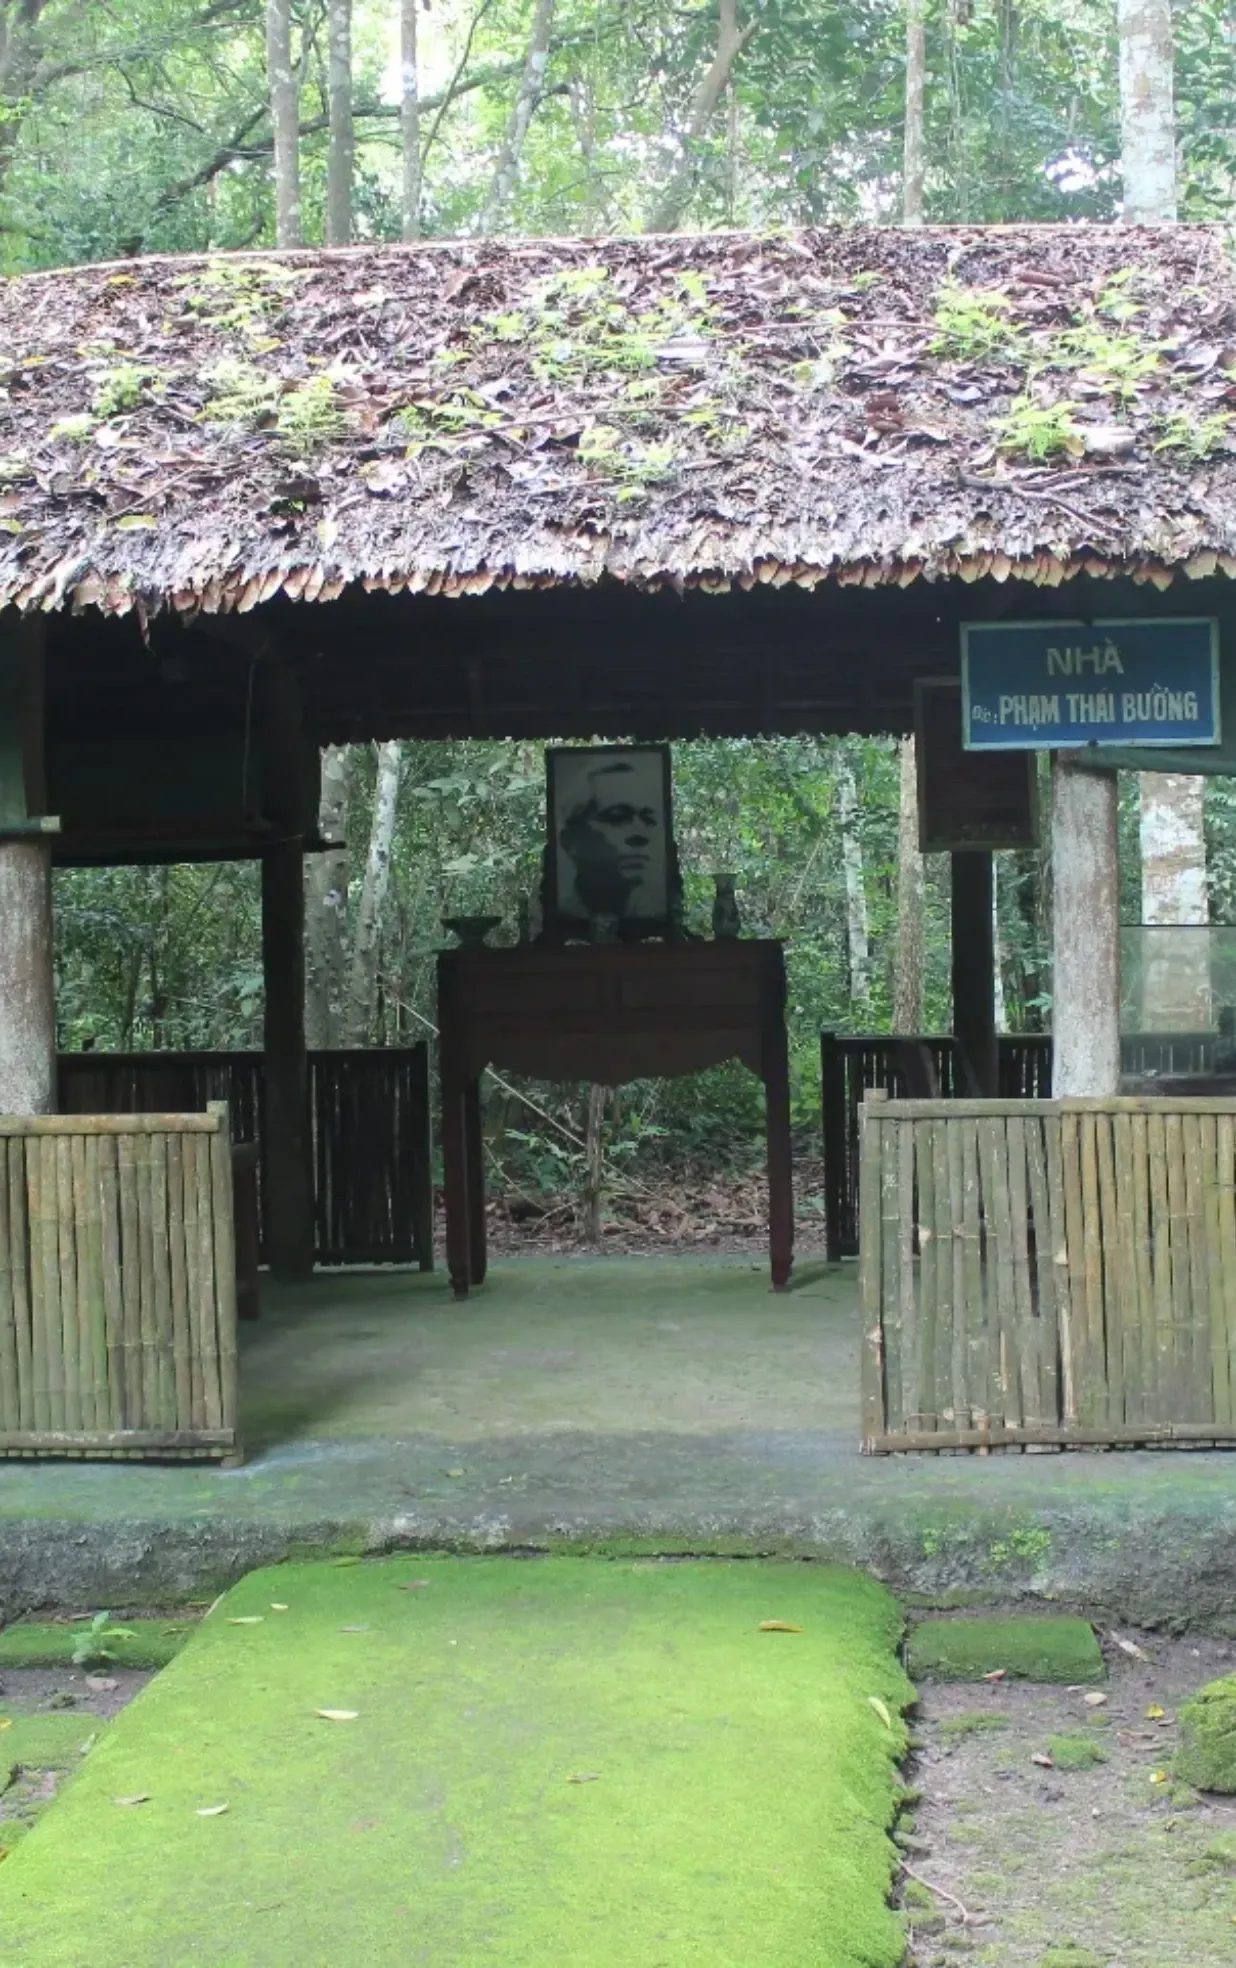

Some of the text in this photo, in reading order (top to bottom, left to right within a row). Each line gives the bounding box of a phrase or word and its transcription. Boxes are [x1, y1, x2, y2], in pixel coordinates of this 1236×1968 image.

[1046, 638, 1124, 676] NHÀ
[1000, 694, 1060, 731] PHẠM
[1065, 687, 1116, 723] THÁI
[1123, 683, 1198, 723] BƯỜNG
